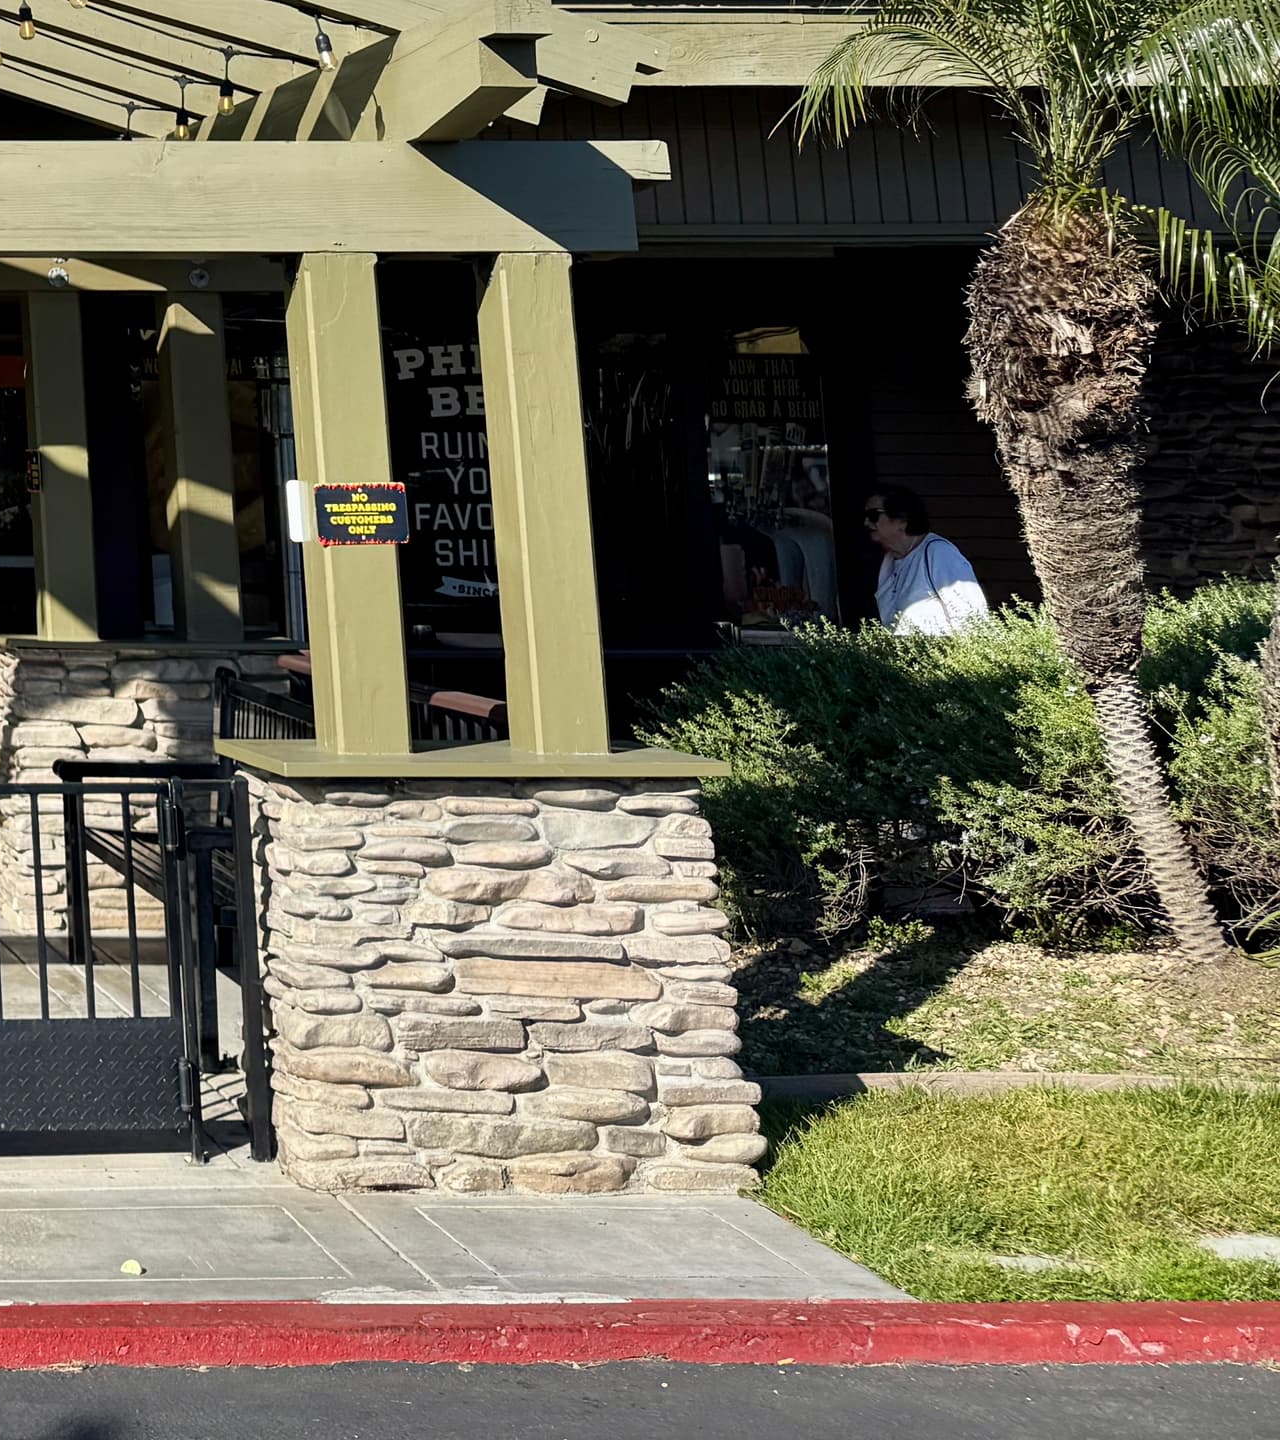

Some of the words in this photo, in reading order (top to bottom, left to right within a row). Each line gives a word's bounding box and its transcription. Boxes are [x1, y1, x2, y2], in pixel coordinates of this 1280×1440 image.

[727, 358, 757, 377] NOW
[764, 358, 797, 377] THAT
[711, 399, 729, 418] GO
[733, 399, 767, 419] GRAB
[772, 399, 782, 417] A
[351, 493, 368, 502] NO
[324, 503, 397, 512] TRESPASSING
[330, 515, 394, 525] CUSTOMERS
[348, 525, 377, 535] ONLY
